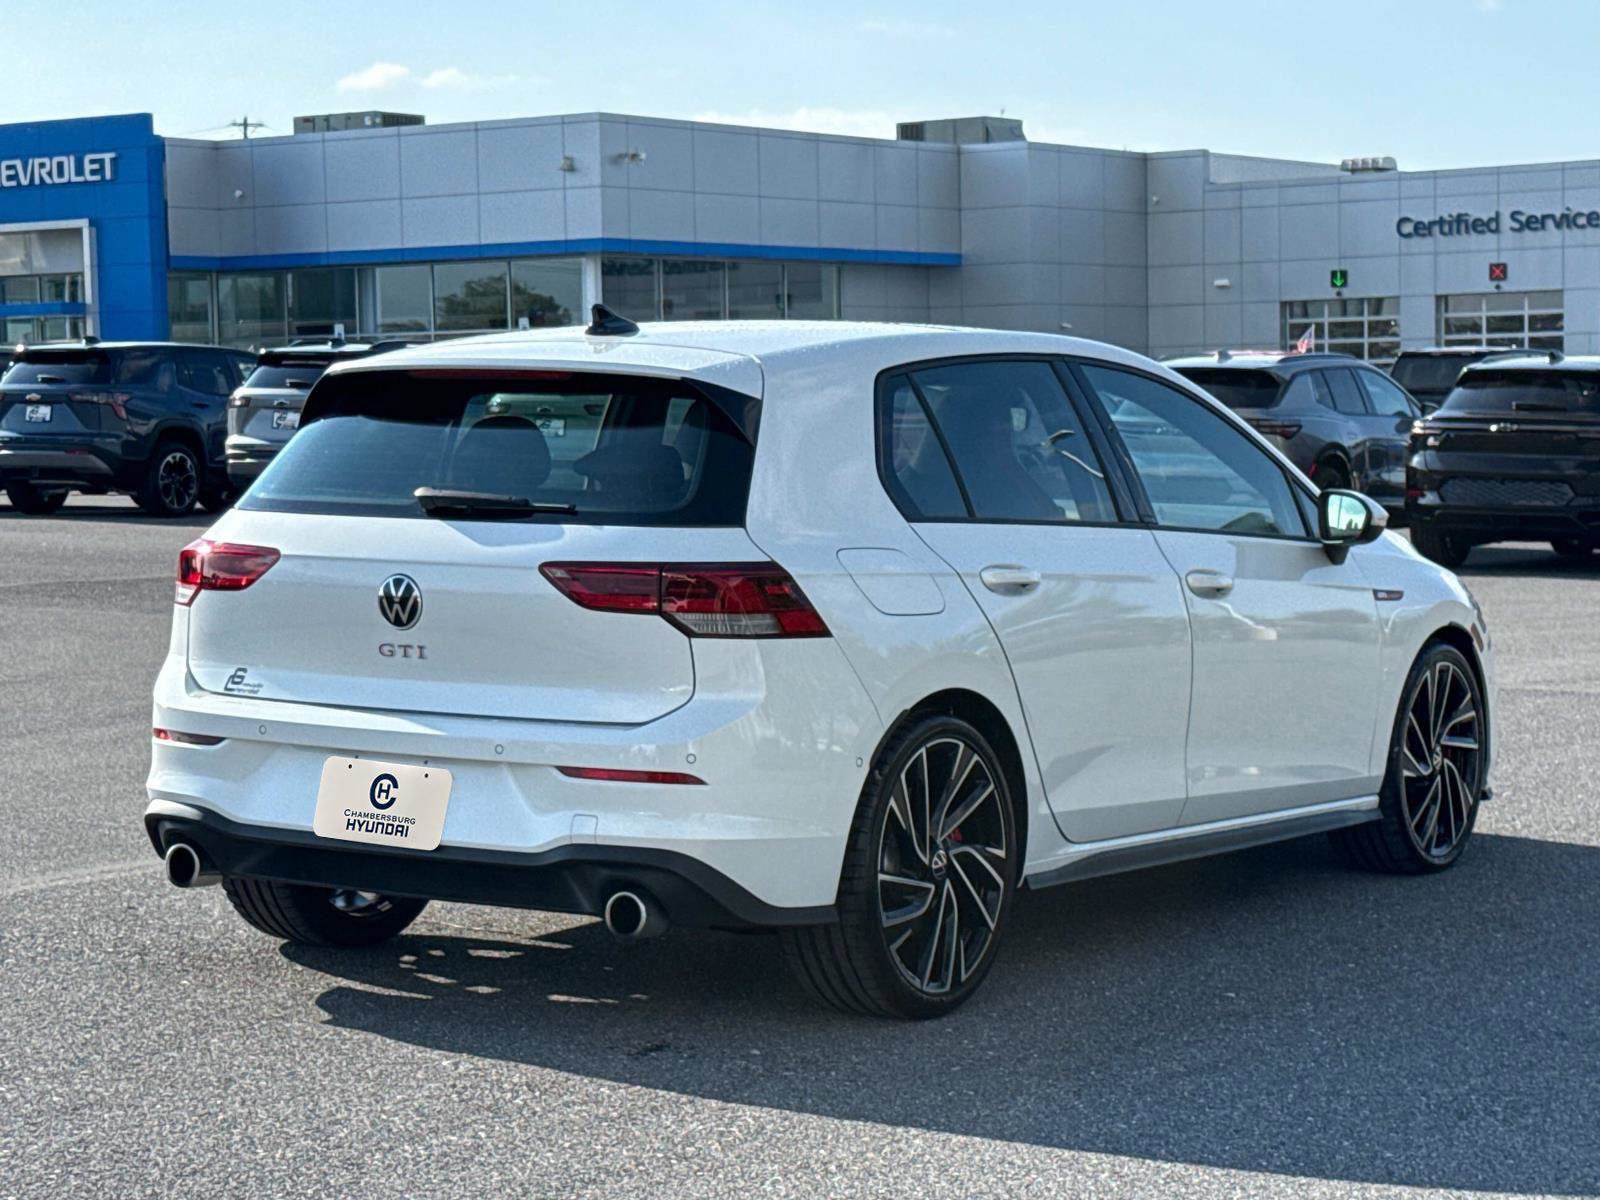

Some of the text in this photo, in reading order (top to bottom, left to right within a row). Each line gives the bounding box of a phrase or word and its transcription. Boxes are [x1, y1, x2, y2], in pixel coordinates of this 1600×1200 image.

[1396, 206, 1600, 239] Certified Service
[378, 643, 428, 660] GTI
[345, 818, 409, 838] HYUNDAI
